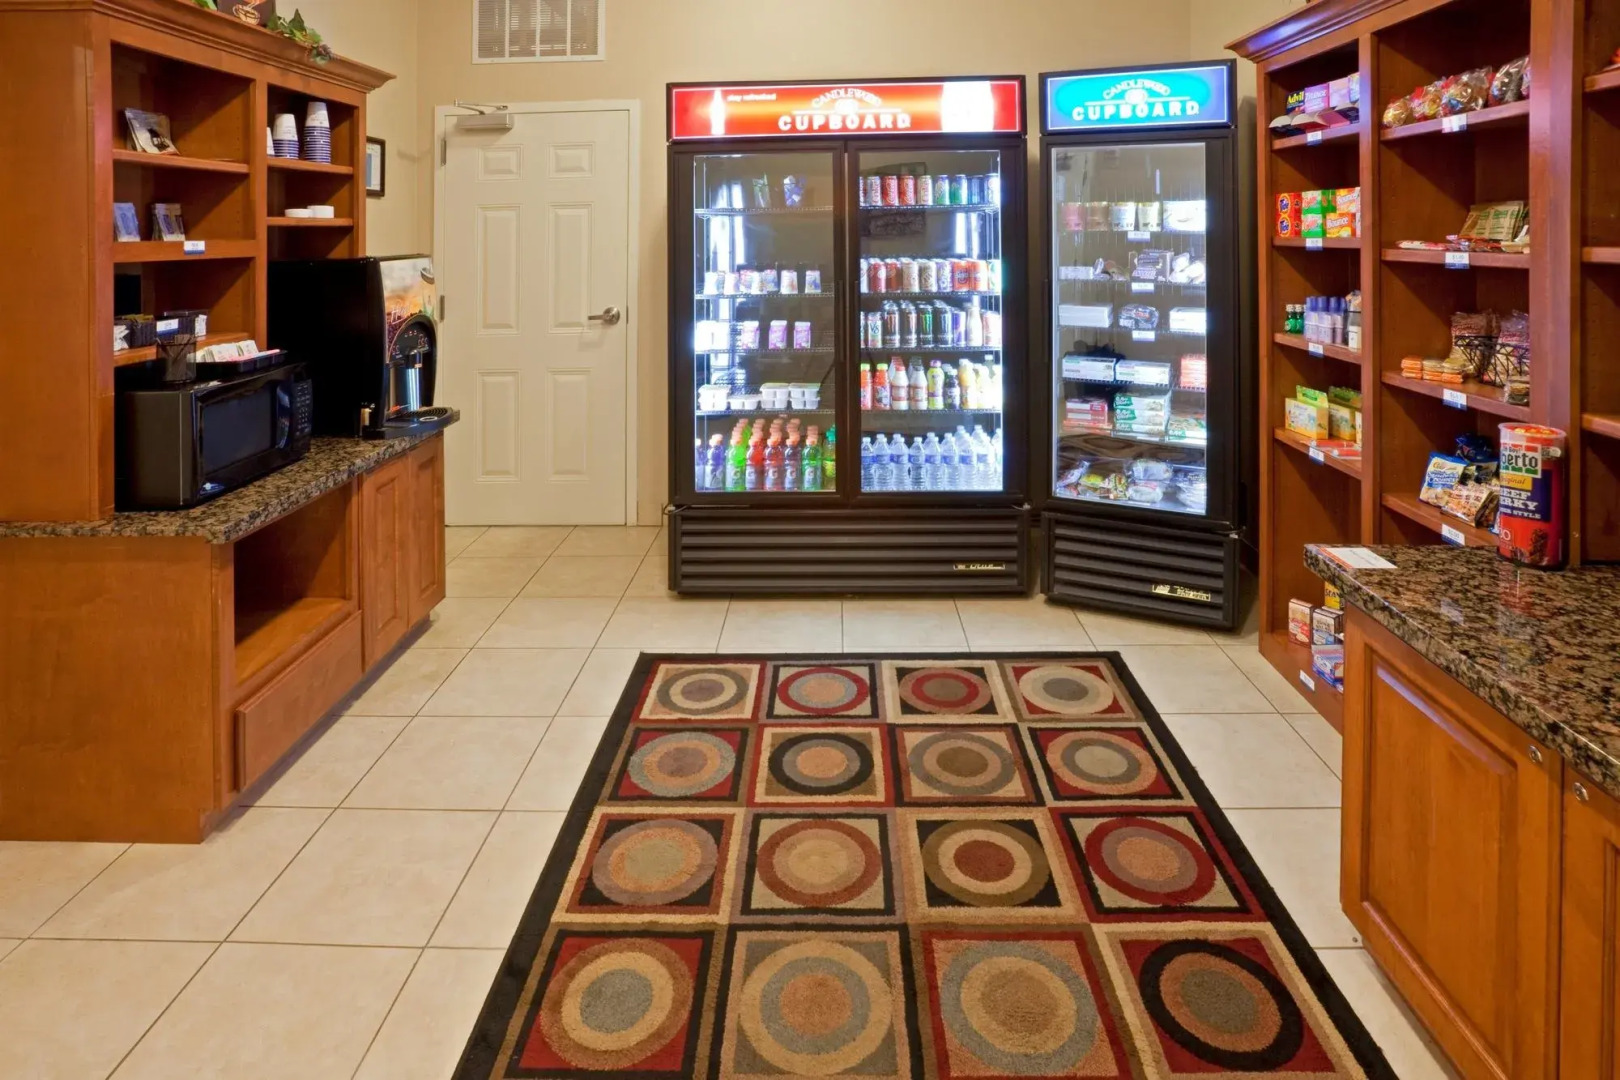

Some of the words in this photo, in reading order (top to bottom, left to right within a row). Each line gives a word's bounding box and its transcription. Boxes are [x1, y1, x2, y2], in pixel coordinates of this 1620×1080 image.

[1288, 90, 1305, 104] Advil
[1072, 100, 1200, 121] CUPBOARD
[777, 113, 912, 131] CUPBOARD
[1327, 217, 1349, 229] Bounce
[870, 323, 880, 335] V8
